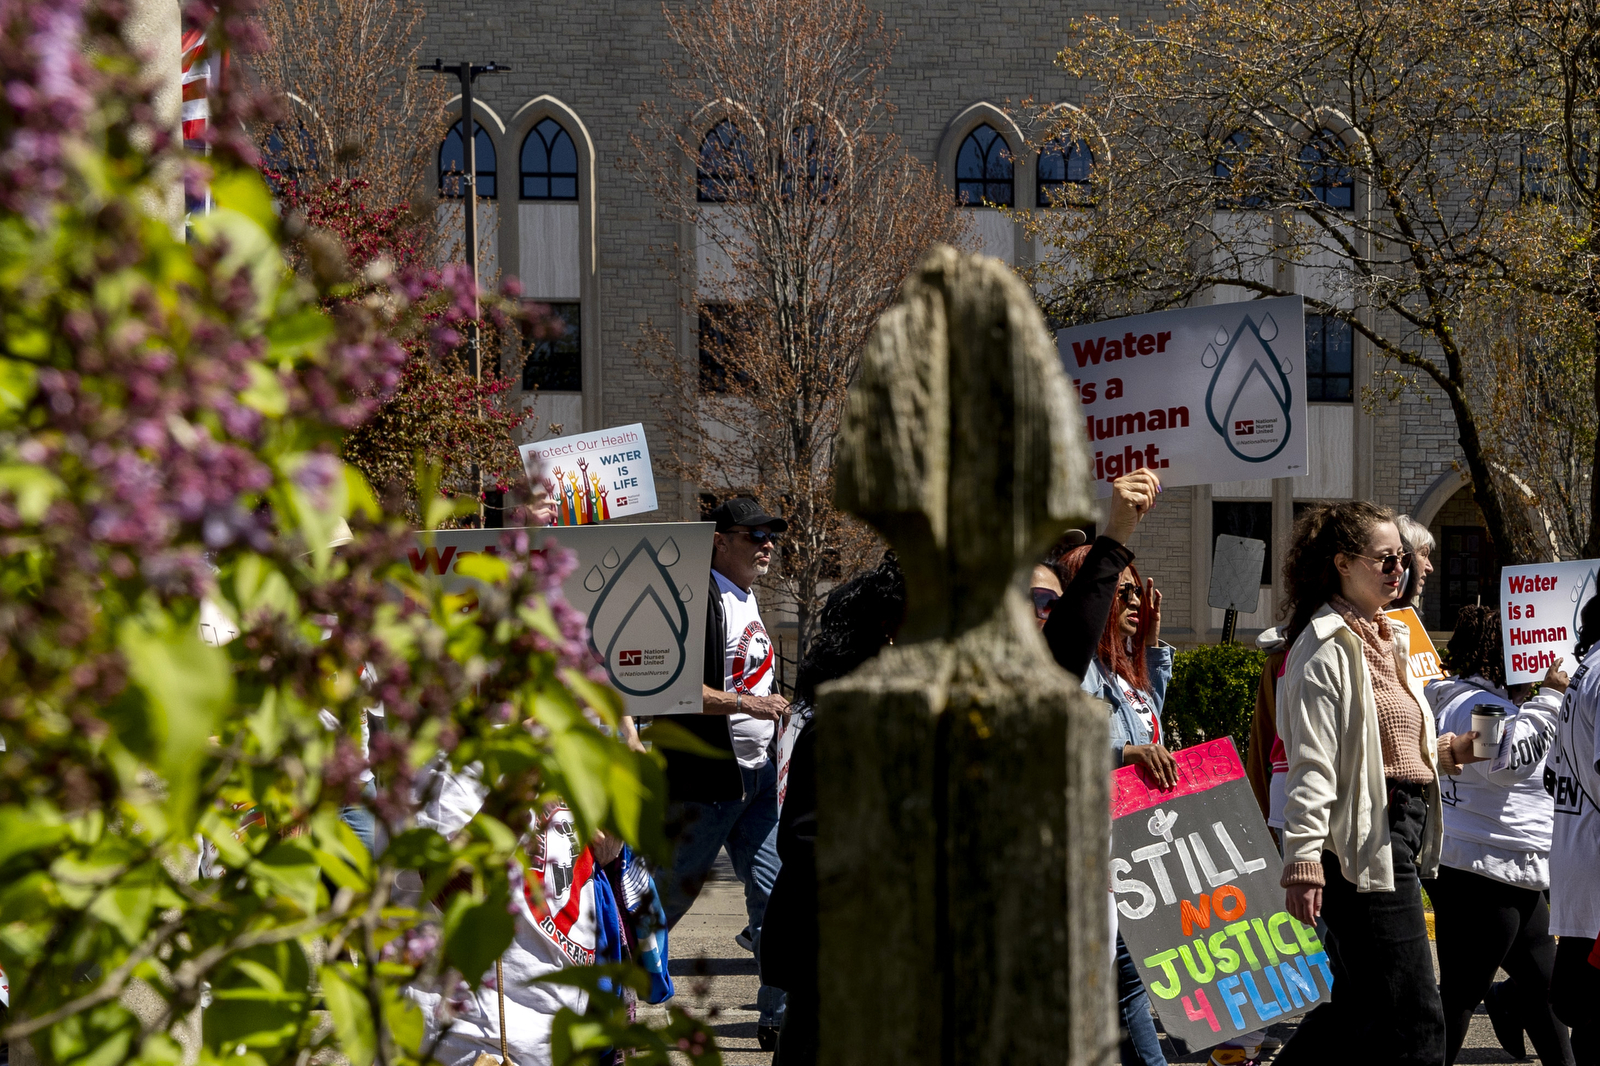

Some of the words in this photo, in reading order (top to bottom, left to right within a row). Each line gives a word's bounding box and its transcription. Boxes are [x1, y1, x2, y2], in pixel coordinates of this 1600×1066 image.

[1072, 331, 1171, 367] Water
[1104, 377, 1123, 399] a
[1255, 417, 1278, 425] National
[528, 443, 574, 461] Protect
[576, 439, 598, 451] Our
[601, 431, 639, 447] Health
[600, 450, 641, 466] WATER
[618, 466, 629, 476] IS
[1091, 444, 1170, 483] ight.
[613, 477, 638, 490] LIFE
[1508, 574, 1558, 594] Water
[1507, 602, 1521, 620] is
[1525, 603, 1535, 619] a
[1510, 626, 1567, 646] Human
[1407, 651, 1441, 678] WER
[1511, 650, 1556, 674] Right
[1129, 744, 1233, 802] YARS
[1108, 821, 1267, 920] STILL
[1180, 885, 1247, 937] NO
[540, 916, 555, 936] 10
[1144, 912, 1324, 1000] JUSTICE
[1180, 988, 1221, 1032] 4
[1217, 951, 1334, 1031] FLINT
